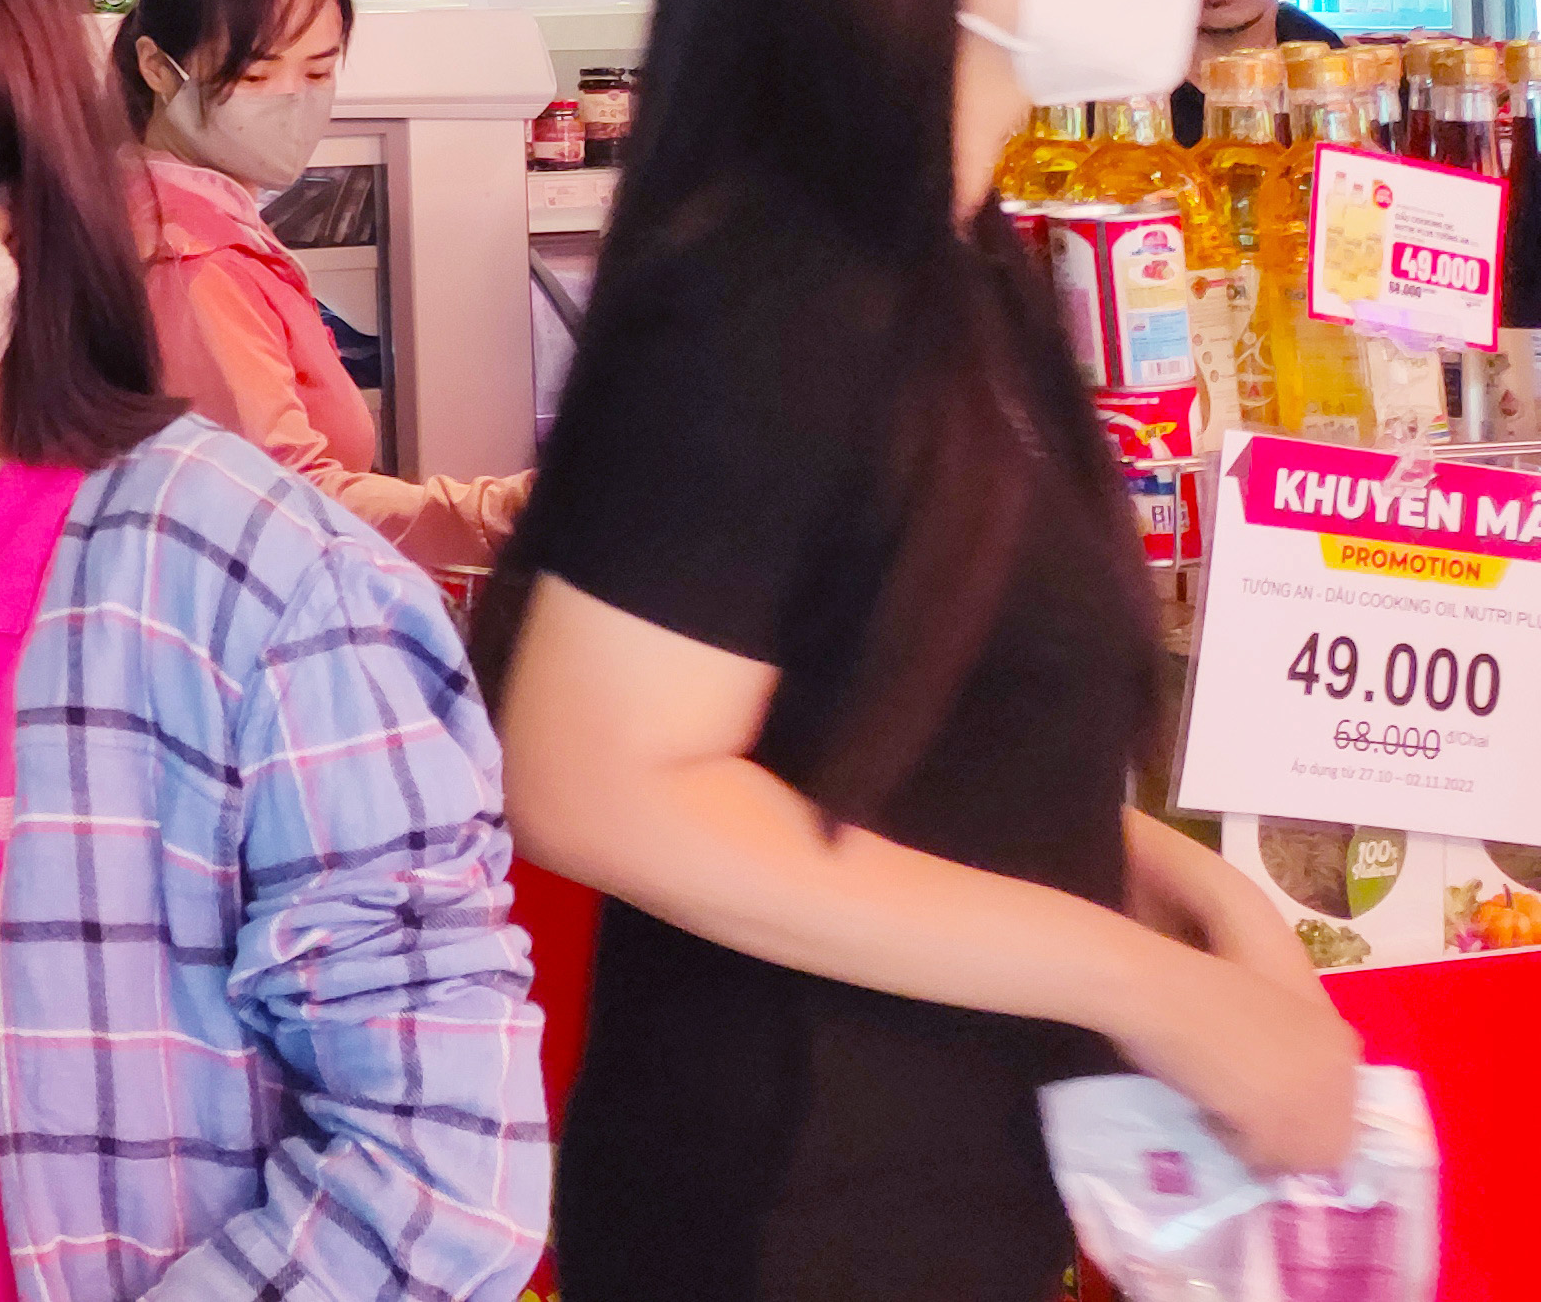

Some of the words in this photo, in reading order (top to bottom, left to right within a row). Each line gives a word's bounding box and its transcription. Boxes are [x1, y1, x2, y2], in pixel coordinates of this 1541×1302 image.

[1400, 246, 1481, 292] 49.000
[1341, 545, 1482, 582] PROMOTION
[1294, 585, 1313, 600] AN
[1358, 590, 1431, 615] COOKING
[1435, 599, 1457, 619] OIL
[1464, 605, 1511, 626] NUTRI
[1287, 632, 1500, 717] 49.000
[1333, 718, 1440, 759] 68.000
